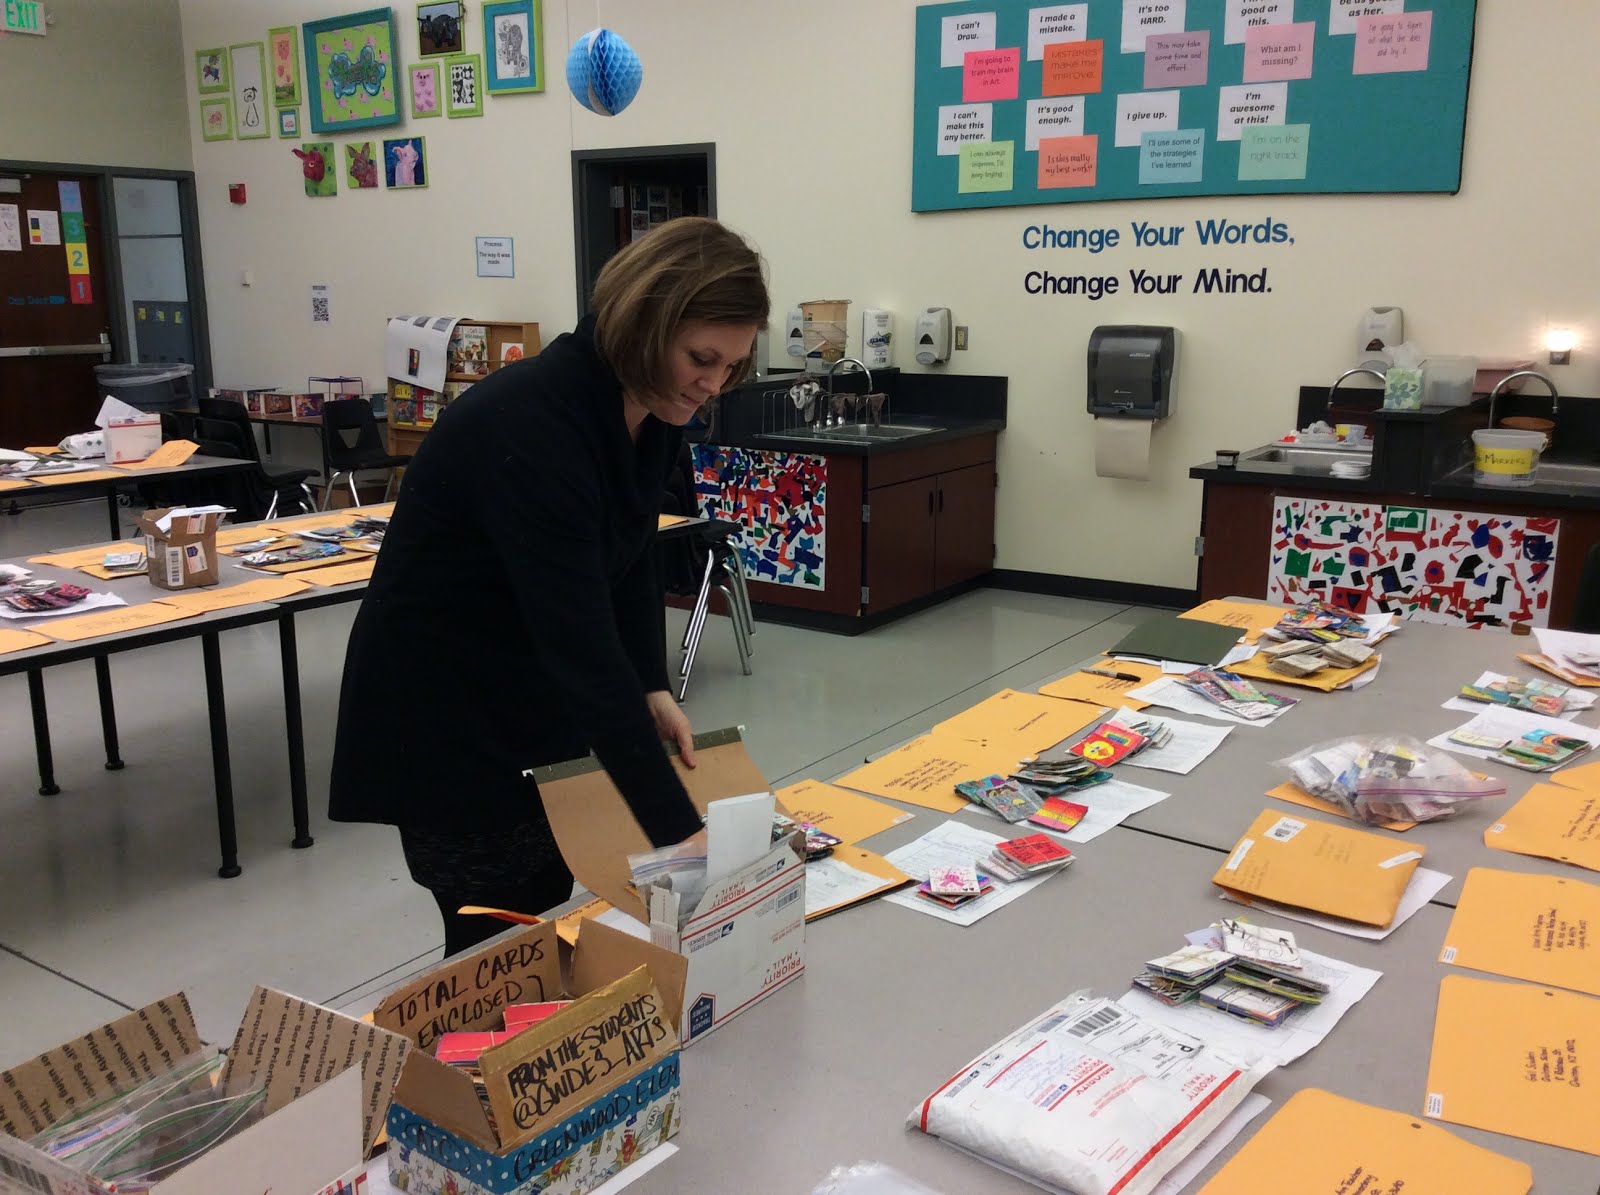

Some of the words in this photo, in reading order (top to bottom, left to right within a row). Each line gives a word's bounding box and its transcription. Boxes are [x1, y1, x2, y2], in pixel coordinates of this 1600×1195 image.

[1138, 6, 1152, 14] It's
[1241, 7, 1265, 16] good
[1363, 7, 1384, 16] her.
[5, 0, 38, 31] EXIT
[1045, 14, 1067, 22] made
[1140, 16, 1166, 25] HARD.
[1248, 17, 1270, 26] this.
[1039, 24, 1075, 35] mistake.
[957, 33, 979, 41] Draw.
[1172, 42, 1184, 50] may
[1260, 46, 1282, 54] What
[985, 57, 1002, 66] going
[1261, 56, 1298, 66] missing?
[972, 69, 986, 77] train
[1245, 93, 1261, 101] I'm
[1038, 106, 1051, 114] It's
[1052, 105, 1074, 114] good
[1229, 105, 1275, 113] awesome
[958, 111, 978, 119] can't
[1132, 112, 1151, 121] give
[1152, 111, 1167, 121] up.
[1234, 117, 1244, 125] at
[1246, 115, 1269, 124] this!
[1038, 116, 1072, 126] enough.
[946, 123, 967, 131] make
[969, 122, 985, 130] this
[944, 134, 959, 142] any
[960, 133, 986, 141] better.
[1192, 137, 1201, 145] of
[1150, 150, 1162, 158] the
[1163, 149, 1197, 158] strategies
[1055, 155, 1070, 163] this
[1056, 165, 1071, 174] best
[1151, 161, 1164, 169] I've
[1165, 161, 1192, 169] learned
[67, 220, 79, 236] 3
[1023, 224, 1120, 254] Change
[1131, 221, 1185, 247] Your
[1195, 216, 1295, 247] Words,
[72, 250, 84, 267] 2
[1024, 270, 1119, 301] Change
[1129, 269, 1183, 294] Your
[1192, 268, 1272, 294] Mind.
[76, 281, 85, 299] 1
[720, 882, 741, 898] MAIL
[709, 884, 746, 910] PRIORITY
[772, 954, 793, 970] MAIL
[761, 956, 802, 989] PRIORITY
[387, 975, 469, 1028] TOTAL
[475, 938, 544, 990] CARDS
[417, 980, 523, 1049] ENCLOSED
[246, 1007, 265, 1057] required
[272, 1012, 290, 1046] using
[303, 1007, 323, 1052] Priority
[142, 1022, 166, 1053] using
[165, 1016, 194, 1056] Service
[252, 1030, 269, 1067] Thank
[284, 1023, 303, 1068] Service
[507, 1048, 558, 1098] FROM
[553, 1032, 585, 1066] THE
[581, 993, 657, 1050] STUDENTS
[1177, 1043, 1195, 1053] P
[80, 1032, 111, 1075] Priority
[312, 1032, 333, 1085] required
[373, 1033, 393, 1079] Priority
[45, 1067, 71, 1100] using
[513, 1095, 630, 1182] GREENWOOD
[635, 1062, 679, 1105] ELEM
